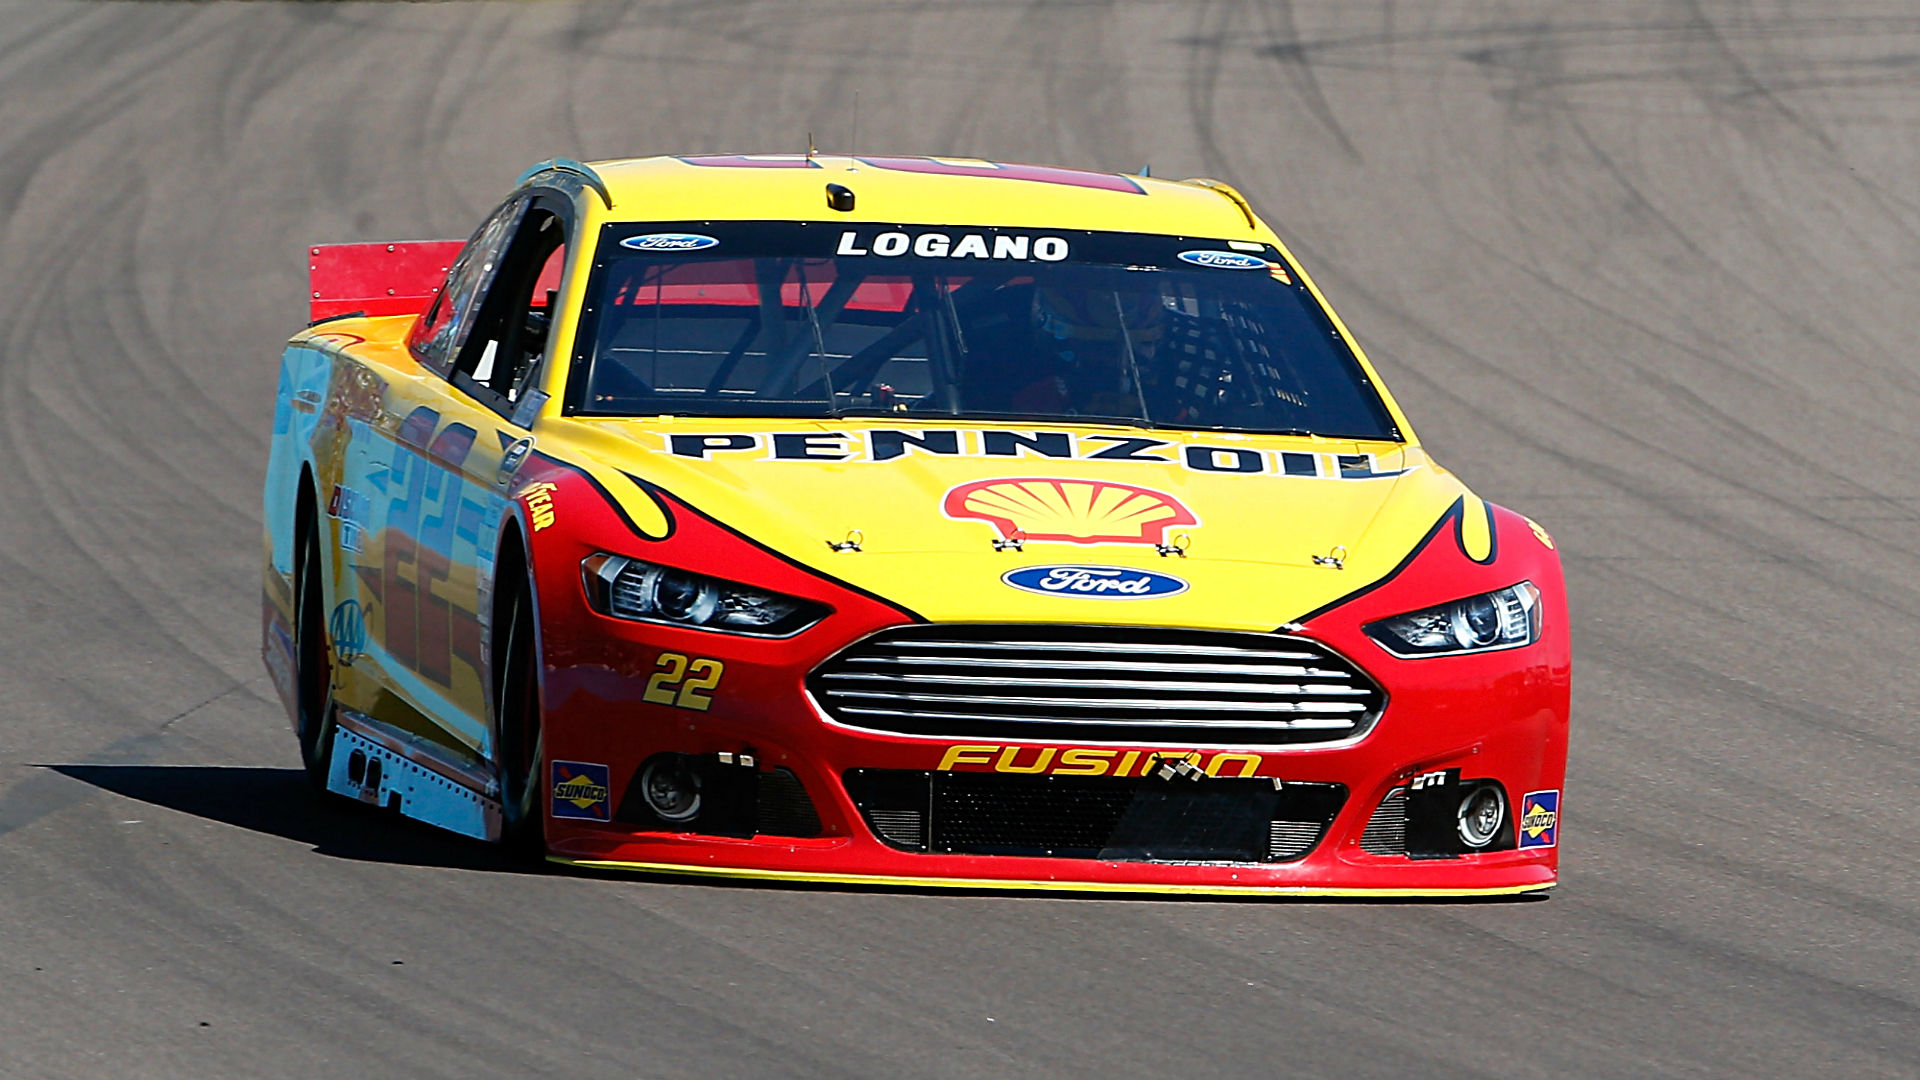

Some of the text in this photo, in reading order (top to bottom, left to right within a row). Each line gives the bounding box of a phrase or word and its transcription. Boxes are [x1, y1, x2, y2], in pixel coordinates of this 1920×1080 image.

[640, 236, 697, 248] Ford
[836, 231, 1069, 261] LOGANO
[1197, 253, 1252, 266] Ford
[667, 430, 1417, 479] PENNZOIL
[1040, 567, 1151, 594] Ford
[642, 651, 724, 711] 22
[555, 784, 606, 800] SUNOCO
